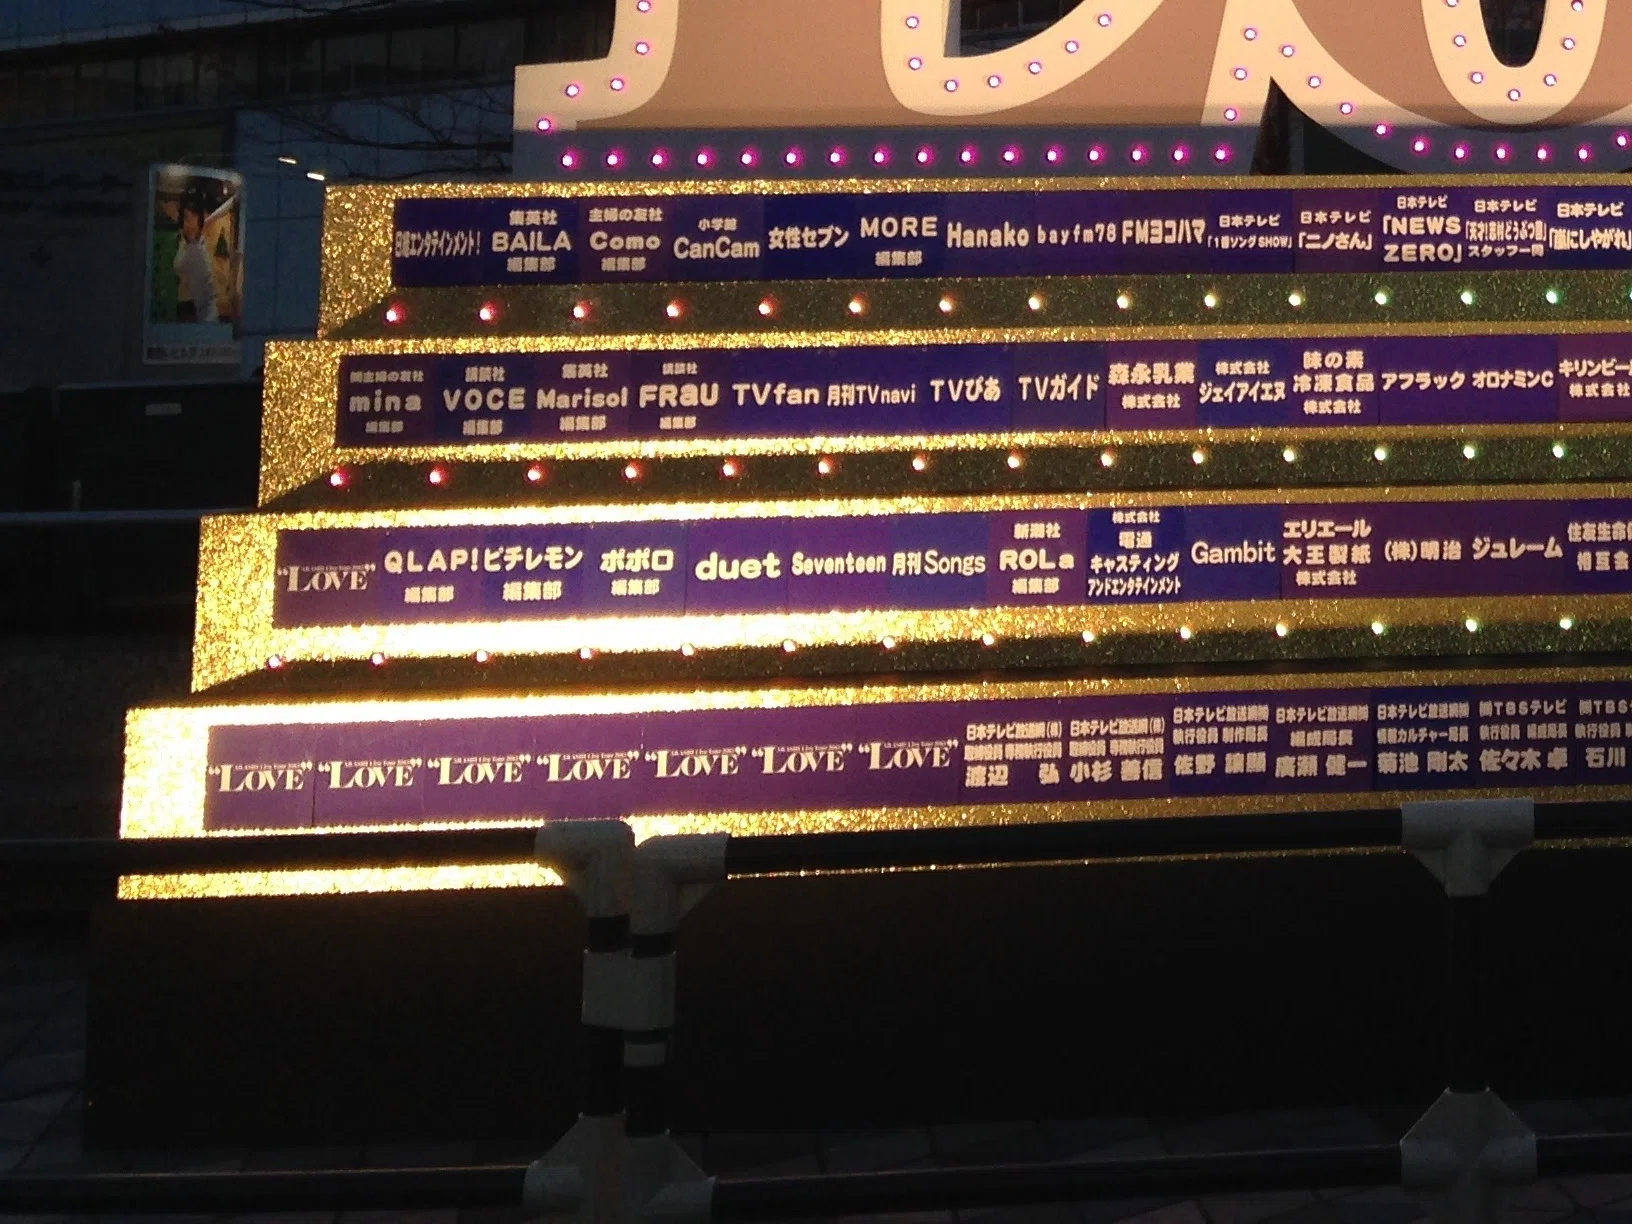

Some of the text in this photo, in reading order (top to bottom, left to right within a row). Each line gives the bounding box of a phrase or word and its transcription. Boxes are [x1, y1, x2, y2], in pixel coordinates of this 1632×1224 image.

[1396, 194, 1449, 210] 日本テレビ
[1474, 198, 1538, 213] 日本テレビ
[1556, 201, 1625, 219] 日本テレビ
[860, 215, 938, 239] MORE
[1218, 213, 1281, 228] 日本テレビ
[1300, 209, 1372, 225] 日本テレビ
[491, 230, 572, 252] BAILA
[589, 230, 661, 251] Como
[768, 225, 850, 250] 女性セブン
[946, 221, 1030, 249] Hanako
[1121, 218, 1206, 245] FMヨコハマ
[673, 235, 761, 260] CanCam
[1215, 360, 1271, 376] 株式会社
[1303, 349, 1364, 370] 味の素
[1107, 360, 1196, 386] 森永乳業
[1292, 372, 1375, 394] 冷凍食品
[1381, 370, 1466, 391] アフラック
[1471, 369, 1554, 390] オロナミンC
[536, 385, 629, 410] Marisol
[731, 382, 820, 406] TVfan
[929, 375, 1001, 403] TVぴあ
[1018, 372, 1100, 401] TVガイド
[1198, 380, 1286, 404] ジェイアイエヌ
[1568, 381, 1631, 398] 株式会社
[348, 388, 422, 413] mina
[442, 387, 526, 412] VOCE
[1121, 392, 1181, 410] 株式会社
[1303, 398, 1362, 415] 株式会社
[1282, 518, 1372, 540] エリエール
[483, 545, 584, 572] ピチレモン
[1190, 539, 1276, 565] Gambit
[1282, 543, 1372, 566] 大王製紙
[1471, 535, 1564, 560] ジュレーム
[384, 547, 479, 575] QLAP!
[599, 547, 675, 573] ポポロ
[694, 551, 782, 581] duet
[791, 551, 887, 576] Seventeen
[1090, 551, 1180, 575] キャスティング
[1295, 568, 1358, 587] 株式会社
[1478, 747, 1542, 772] 佐々木
[1585, 746, 1626, 768] 石川
